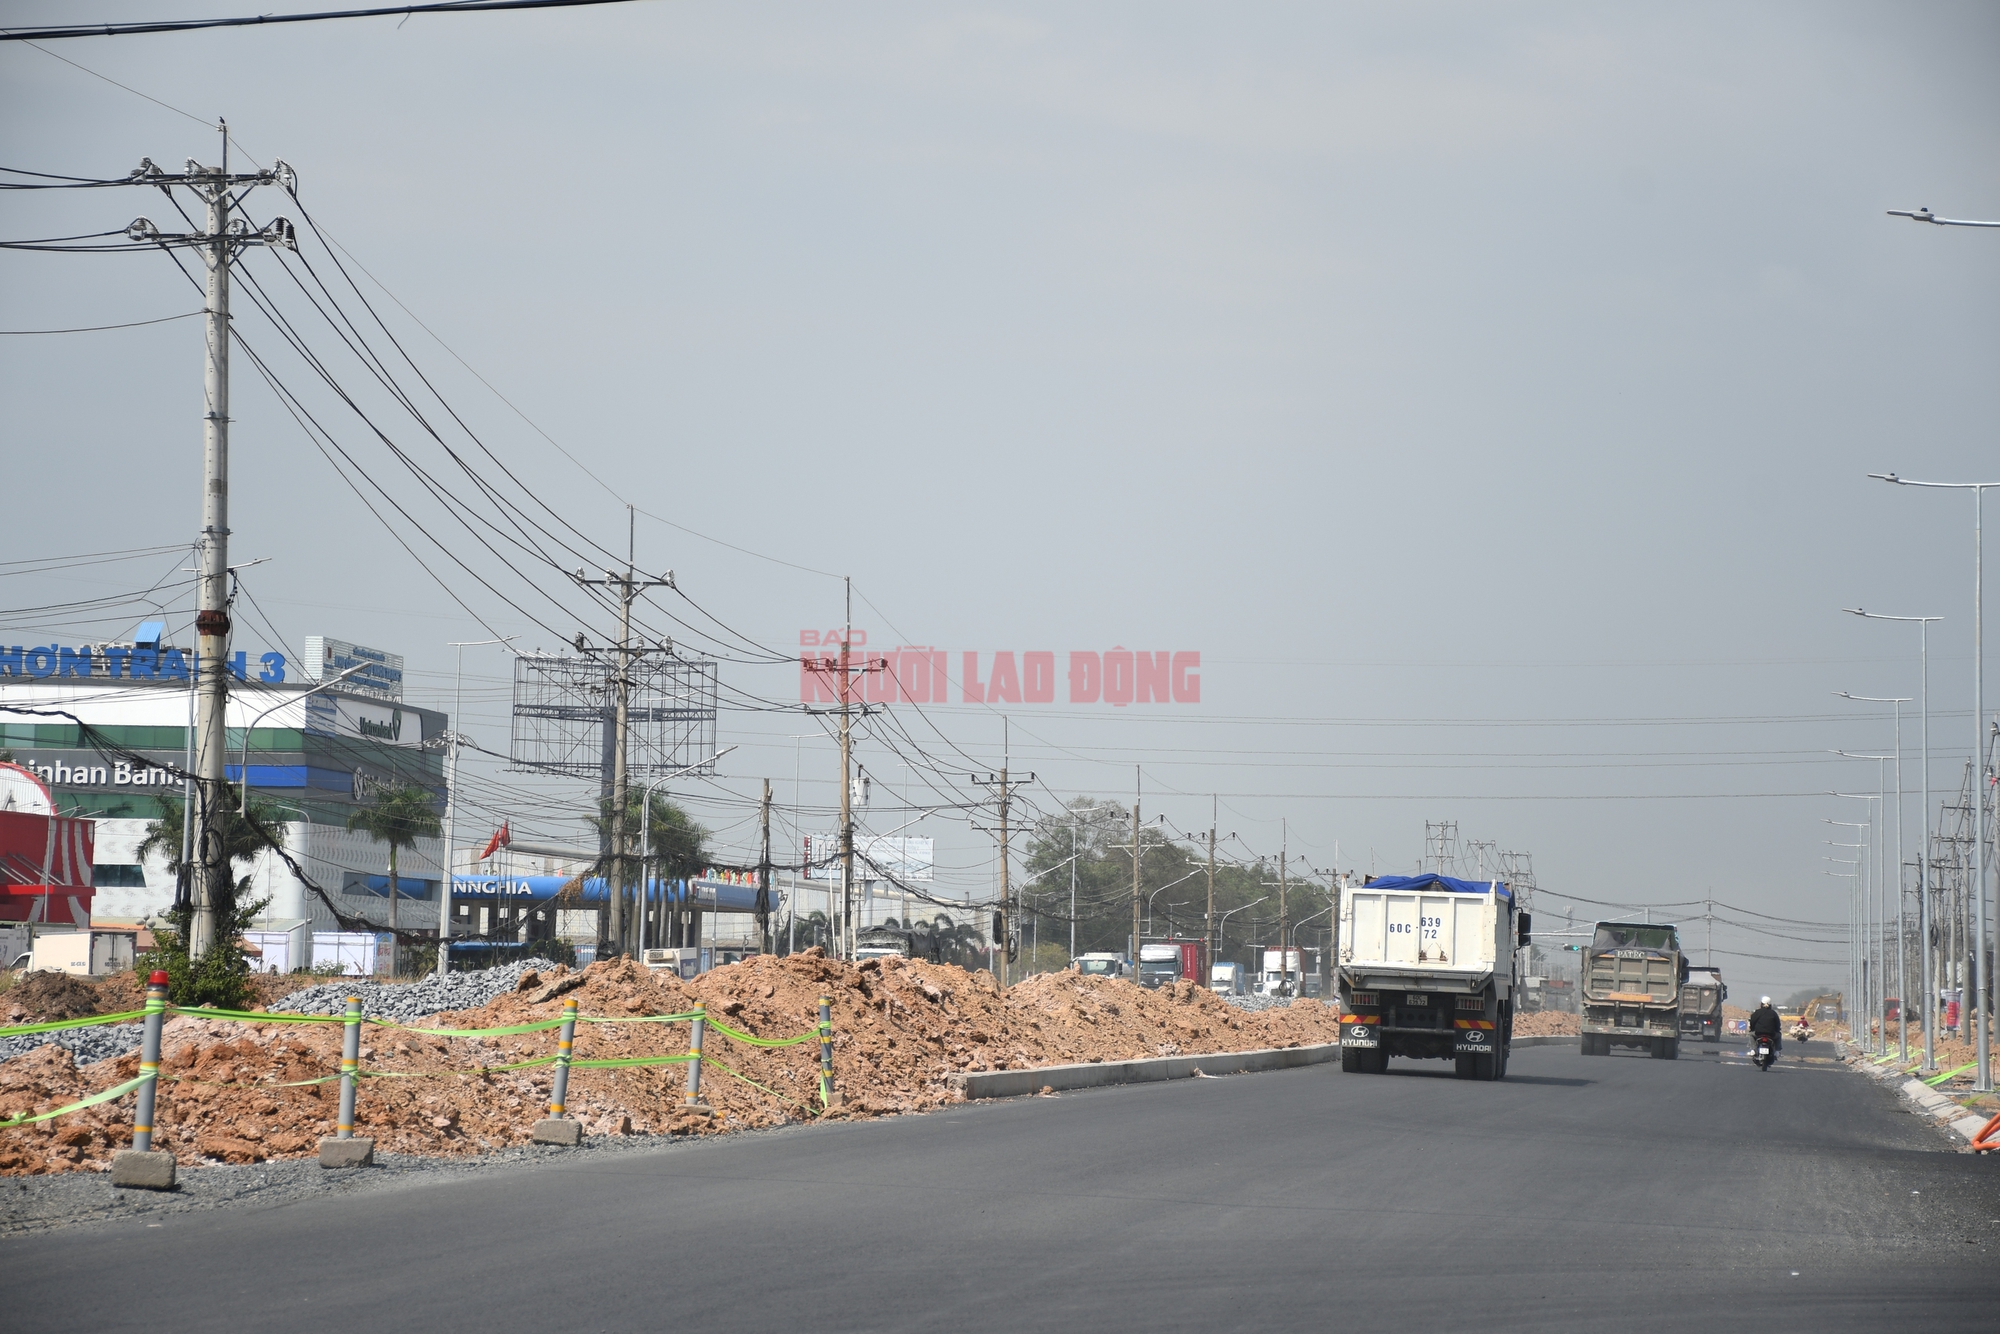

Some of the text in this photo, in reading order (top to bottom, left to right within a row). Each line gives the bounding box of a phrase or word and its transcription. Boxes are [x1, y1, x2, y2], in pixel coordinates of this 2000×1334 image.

[258, 651, 286, 684] 3
[114, 761, 184, 786] Bank
[1420, 916, 1441, 928] 639
[1389, 923, 1412, 934] 60C
[1424, 929, 1438, 939] 72
[1617, 950, 1645, 959] PATEC
[1341, 1038, 1378, 1048] HYUNDAI
[1456, 1043, 1492, 1053] HYUNDAI
